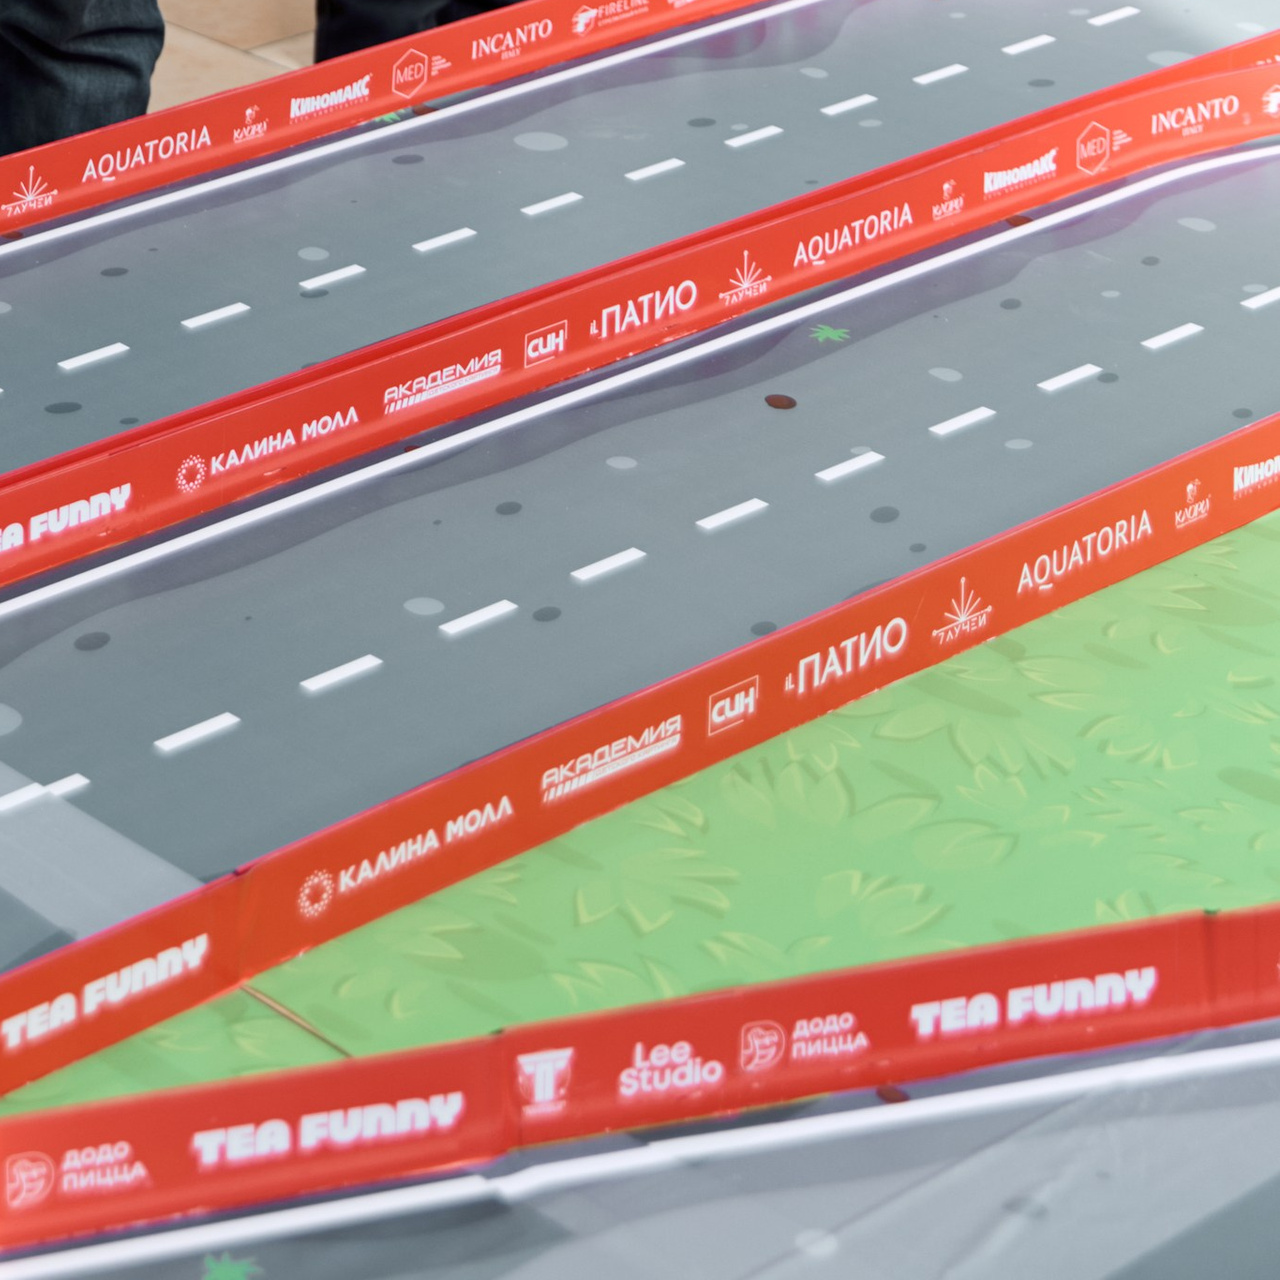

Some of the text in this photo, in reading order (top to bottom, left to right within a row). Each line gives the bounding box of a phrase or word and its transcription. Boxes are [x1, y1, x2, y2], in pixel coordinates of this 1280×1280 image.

[471, 19, 553, 60] INCANTO
[290, 74, 370, 119] КИНОМАКС
[396, 62, 424, 84] MED
[1151, 95, 1239, 135] INCANTO
[82, 125, 212, 182] AQUATORIA
[983, 148, 1057, 194] КИНОМАКС
[1079, 137, 1106, 159] MED
[793, 202, 913, 267] AQUATORIA
[602, 280, 697, 338] ПАТИО
[384, 348, 502, 404] АКАДЕМИЯ
[211, 406, 359, 474] КАЛИНА МОЛЛ
[30, 484, 132, 541] FUNNY
[1017, 509, 1152, 593] AQUATORIA
[797, 617, 907, 693] ПАТИО
[542, 714, 681, 789] АКАДЕМИЯ
[339, 795, 513, 892] КАЛИНА МОЛЛ
[0, 933, 208, 1049] TEA FUNNY
[911, 968, 1157, 1040] TEA FUNNY
[792, 1012, 855, 1038] ДОДО
[792, 1031, 868, 1059] ПИЦЦА
[620, 1058, 723, 1097] Studio
[635, 1040, 690, 1069] Lee
[63, 1141, 130, 1169] ДОДО
[194, 1092, 465, 1167] TEA FUNNY
[63, 1161, 146, 1191] ПИЦЦА
